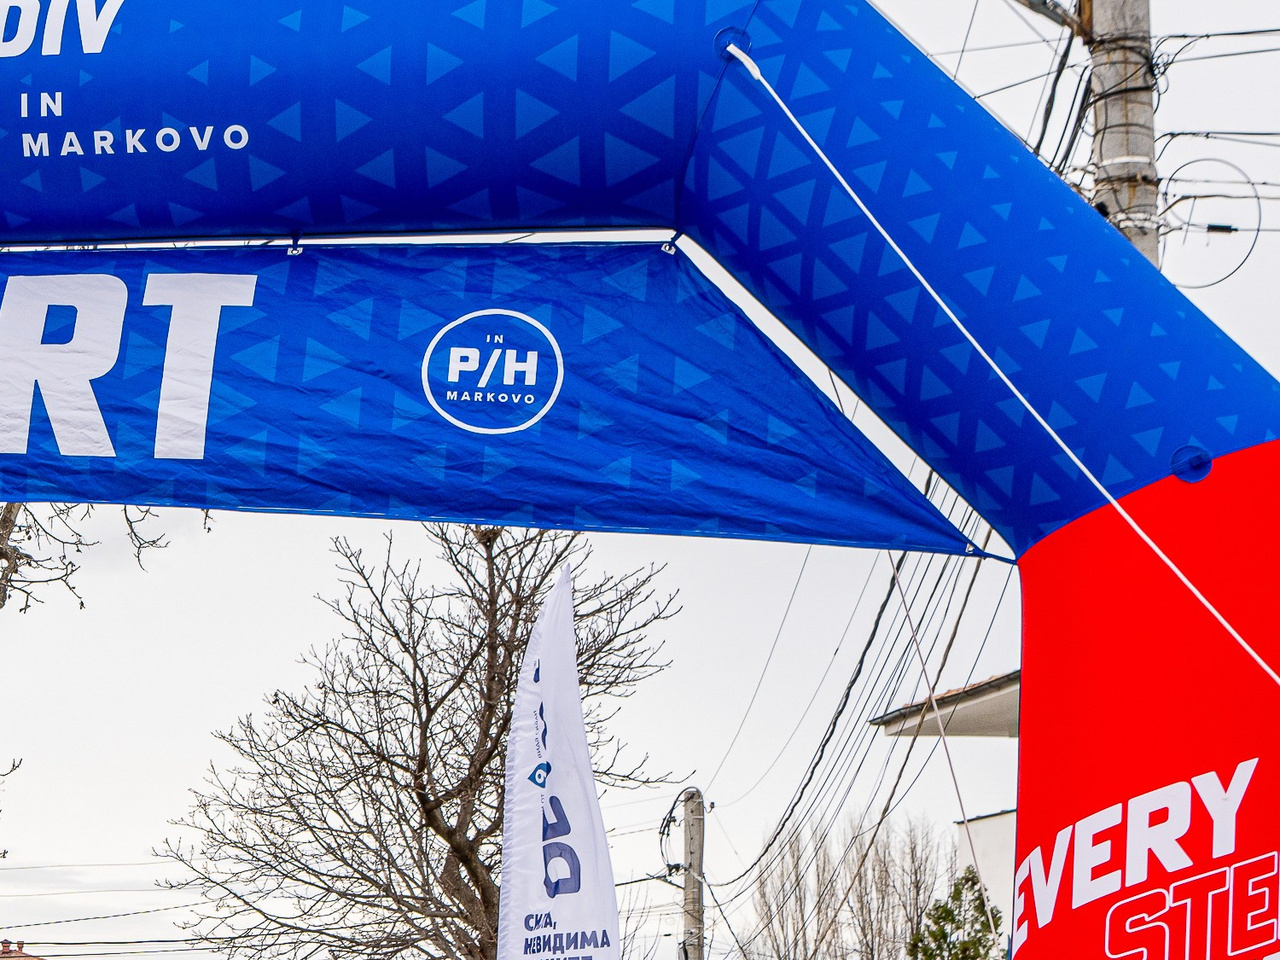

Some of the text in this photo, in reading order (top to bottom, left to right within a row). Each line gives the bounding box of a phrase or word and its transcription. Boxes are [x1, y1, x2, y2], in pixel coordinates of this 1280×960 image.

[20, 91, 62, 117] IN
[22, 124, 250, 157] MARKOVO
[486, 334, 504, 343] IN
[447, 347, 538, 388] P/H
[446, 390, 535, 404] MARKOVO
[1011, 757, 1260, 960] EVERY
[523, 929, 610, 955] НЕВИДИМА
